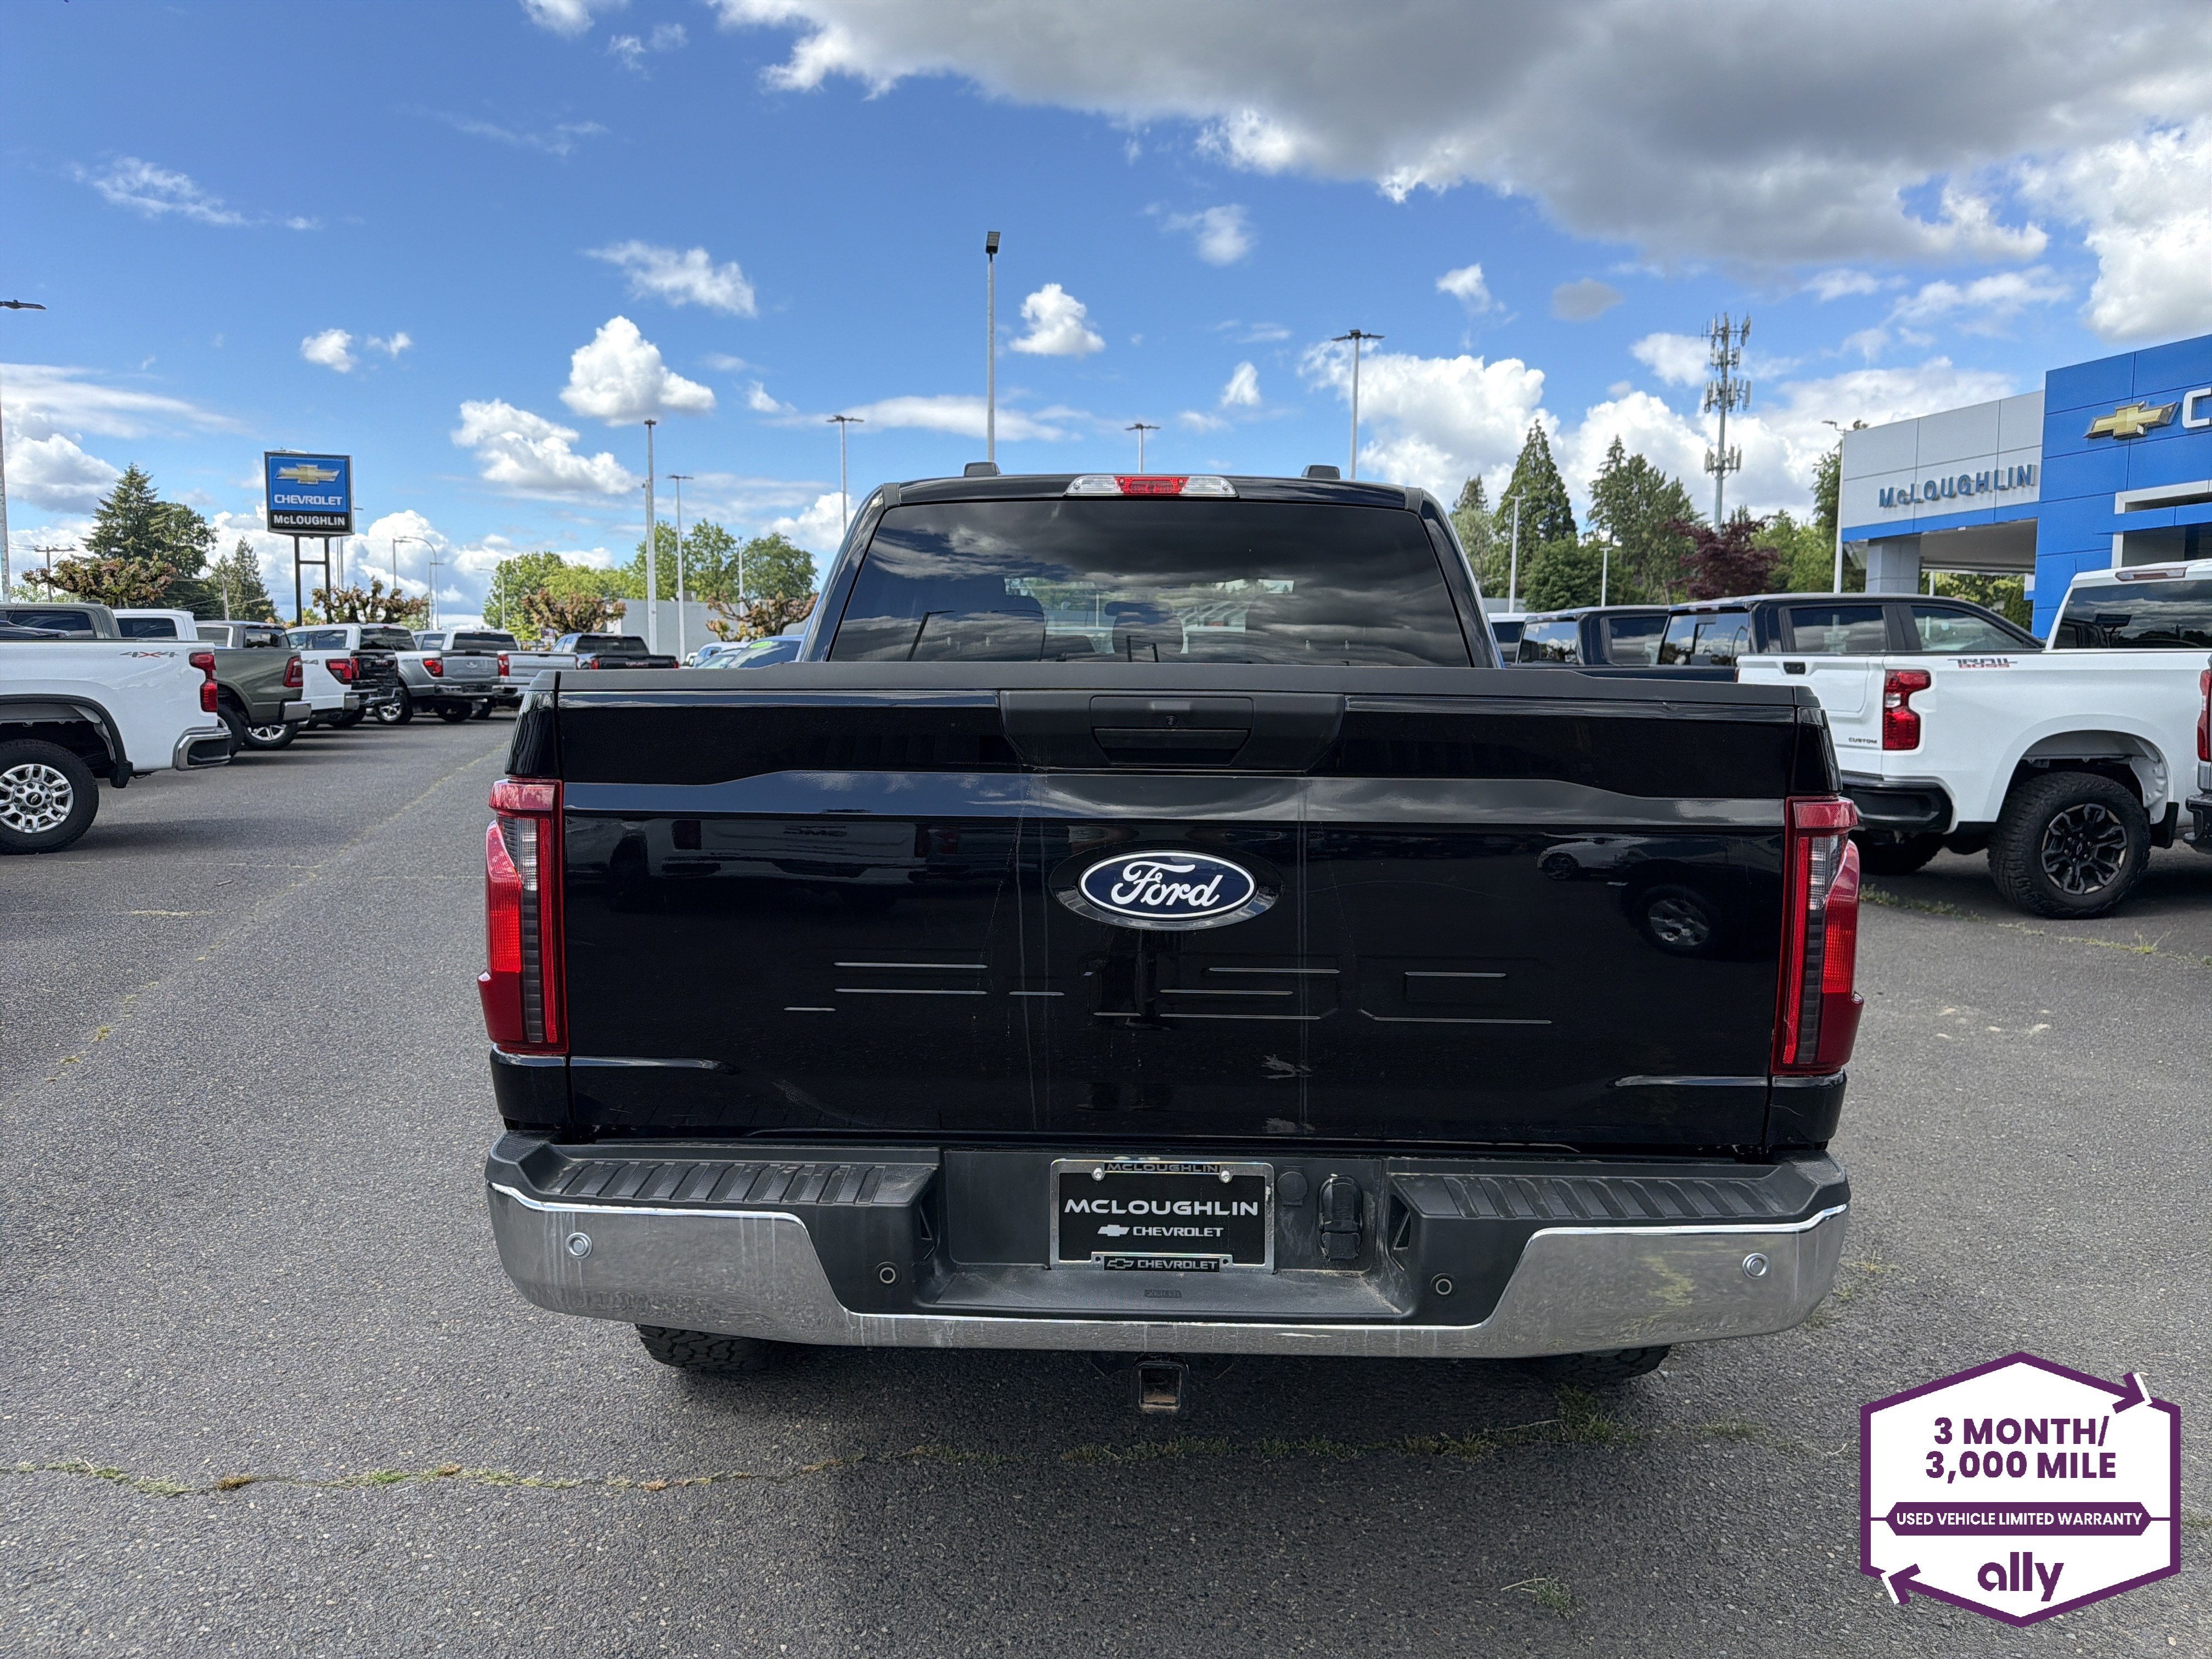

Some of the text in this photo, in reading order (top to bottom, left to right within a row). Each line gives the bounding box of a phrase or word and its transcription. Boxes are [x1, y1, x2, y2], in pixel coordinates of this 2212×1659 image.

[1879, 465, 2034, 507] McLOUGHLIN
[274, 494, 343, 506] CHEVROLET
[274, 515, 345, 526] McLOUGHLIN
[1111, 861, 1223, 907] Ford
[1106, 1163, 1218, 1173] MCLOUGHLIN
[1064, 1199, 1258, 1216] MCLOUGHLIN
[1133, 1226, 1224, 1238] CHEVROLET
[1137, 1260, 1218, 1269] CHEVROLET
